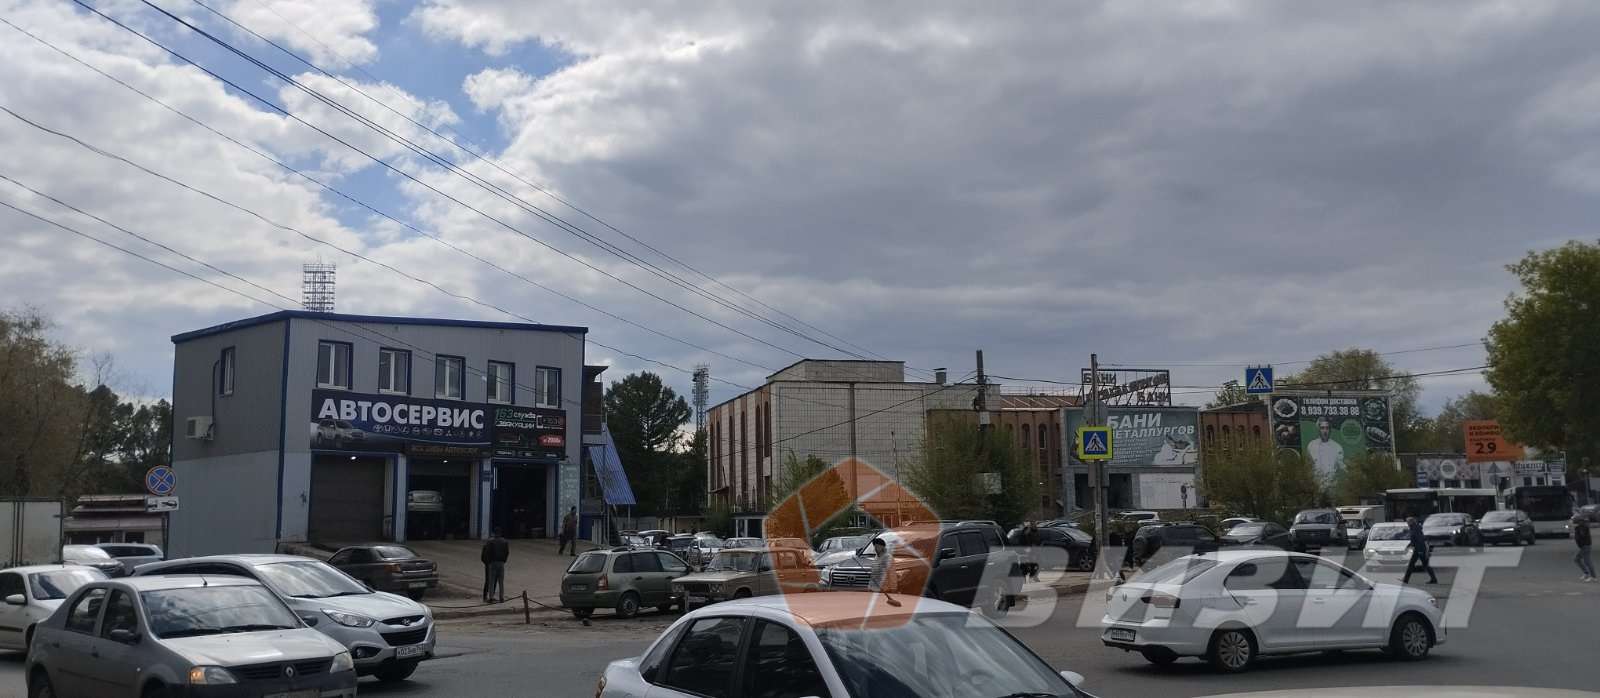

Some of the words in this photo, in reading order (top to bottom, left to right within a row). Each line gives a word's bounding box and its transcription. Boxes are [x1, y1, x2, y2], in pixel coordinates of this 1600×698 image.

[318, 398, 484, 429] АВТОСЕРВИС
[1107, 412, 1161, 429] БАНИ
[1112, 425, 1195, 439] ЕТАЛЛУРГОВ
